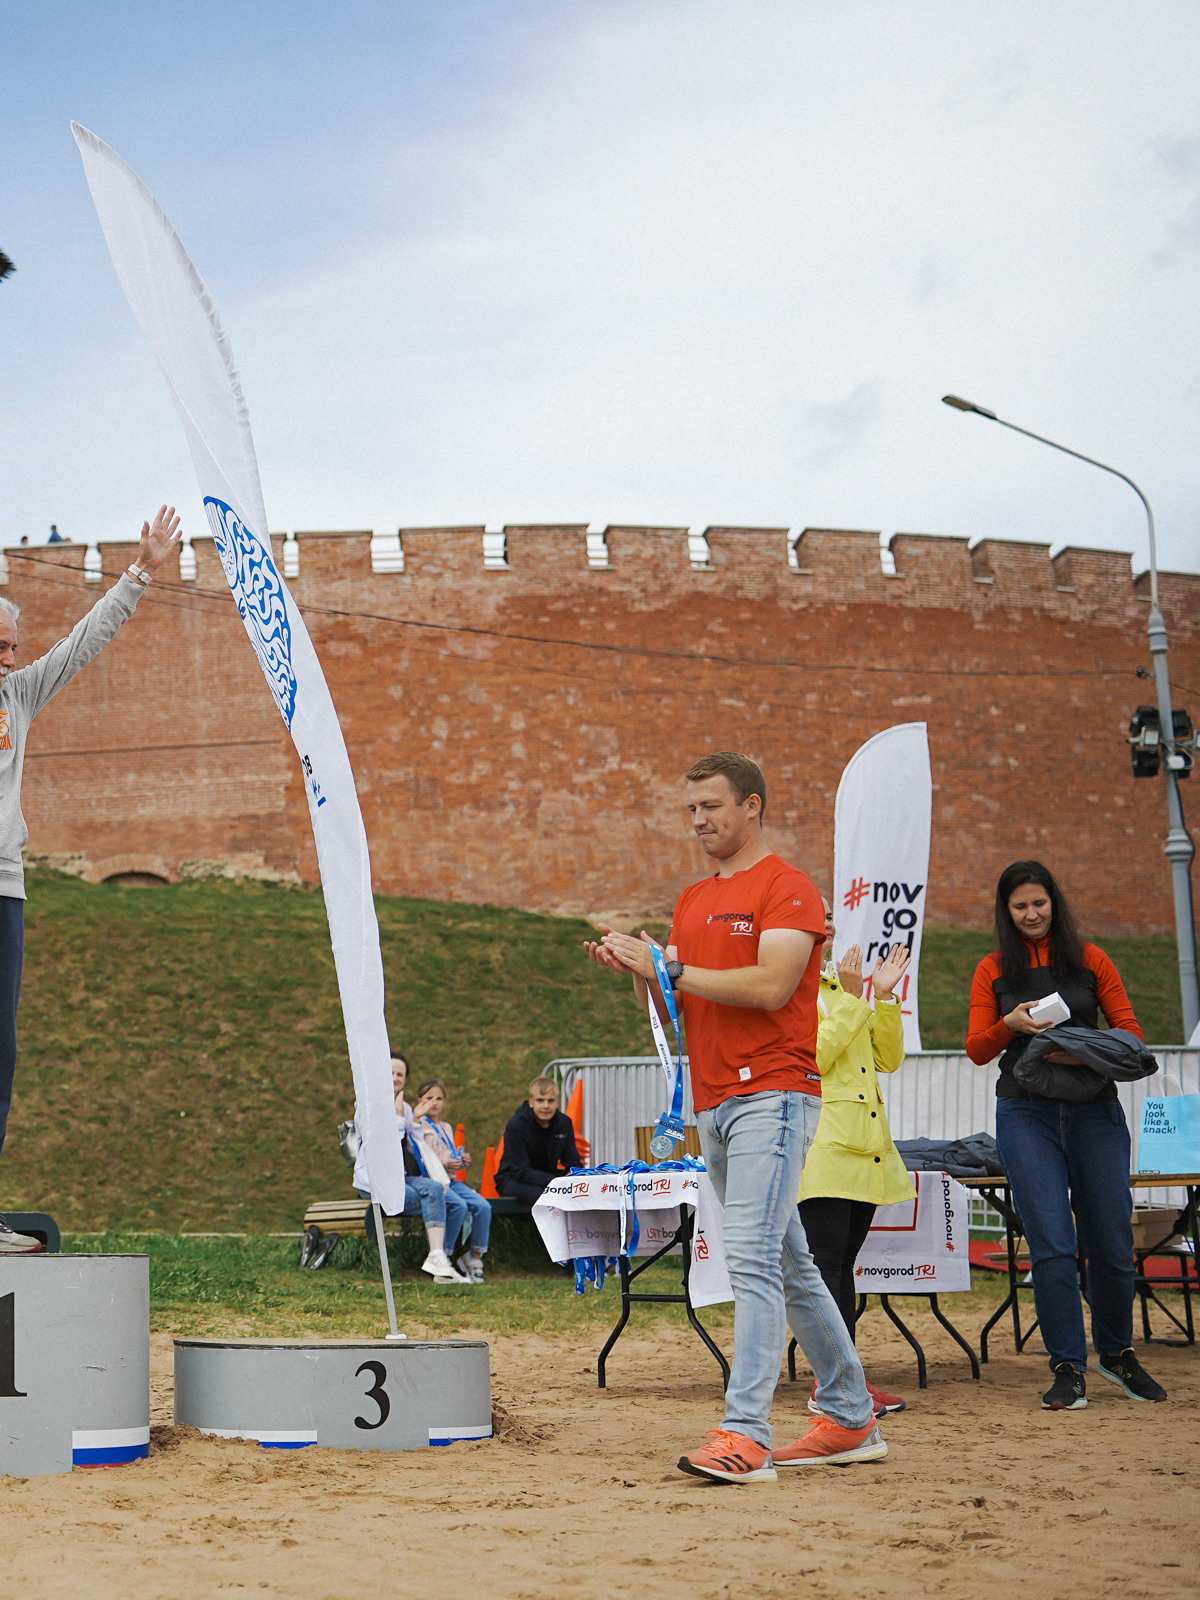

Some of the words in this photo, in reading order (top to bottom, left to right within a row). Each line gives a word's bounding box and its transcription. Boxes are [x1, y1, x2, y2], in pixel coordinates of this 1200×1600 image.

[844, 877, 924, 911] #nov
[731, 921, 754, 932] TRI
[882, 907, 918, 938] go
[1147, 1101, 1164, 1110] You
[1145, 1109, 1166, 1118] look
[1144, 1118, 1162, 1126] like
[1143, 1126, 1177, 1134] snack!
[355, 1361, 390, 1429] 3
